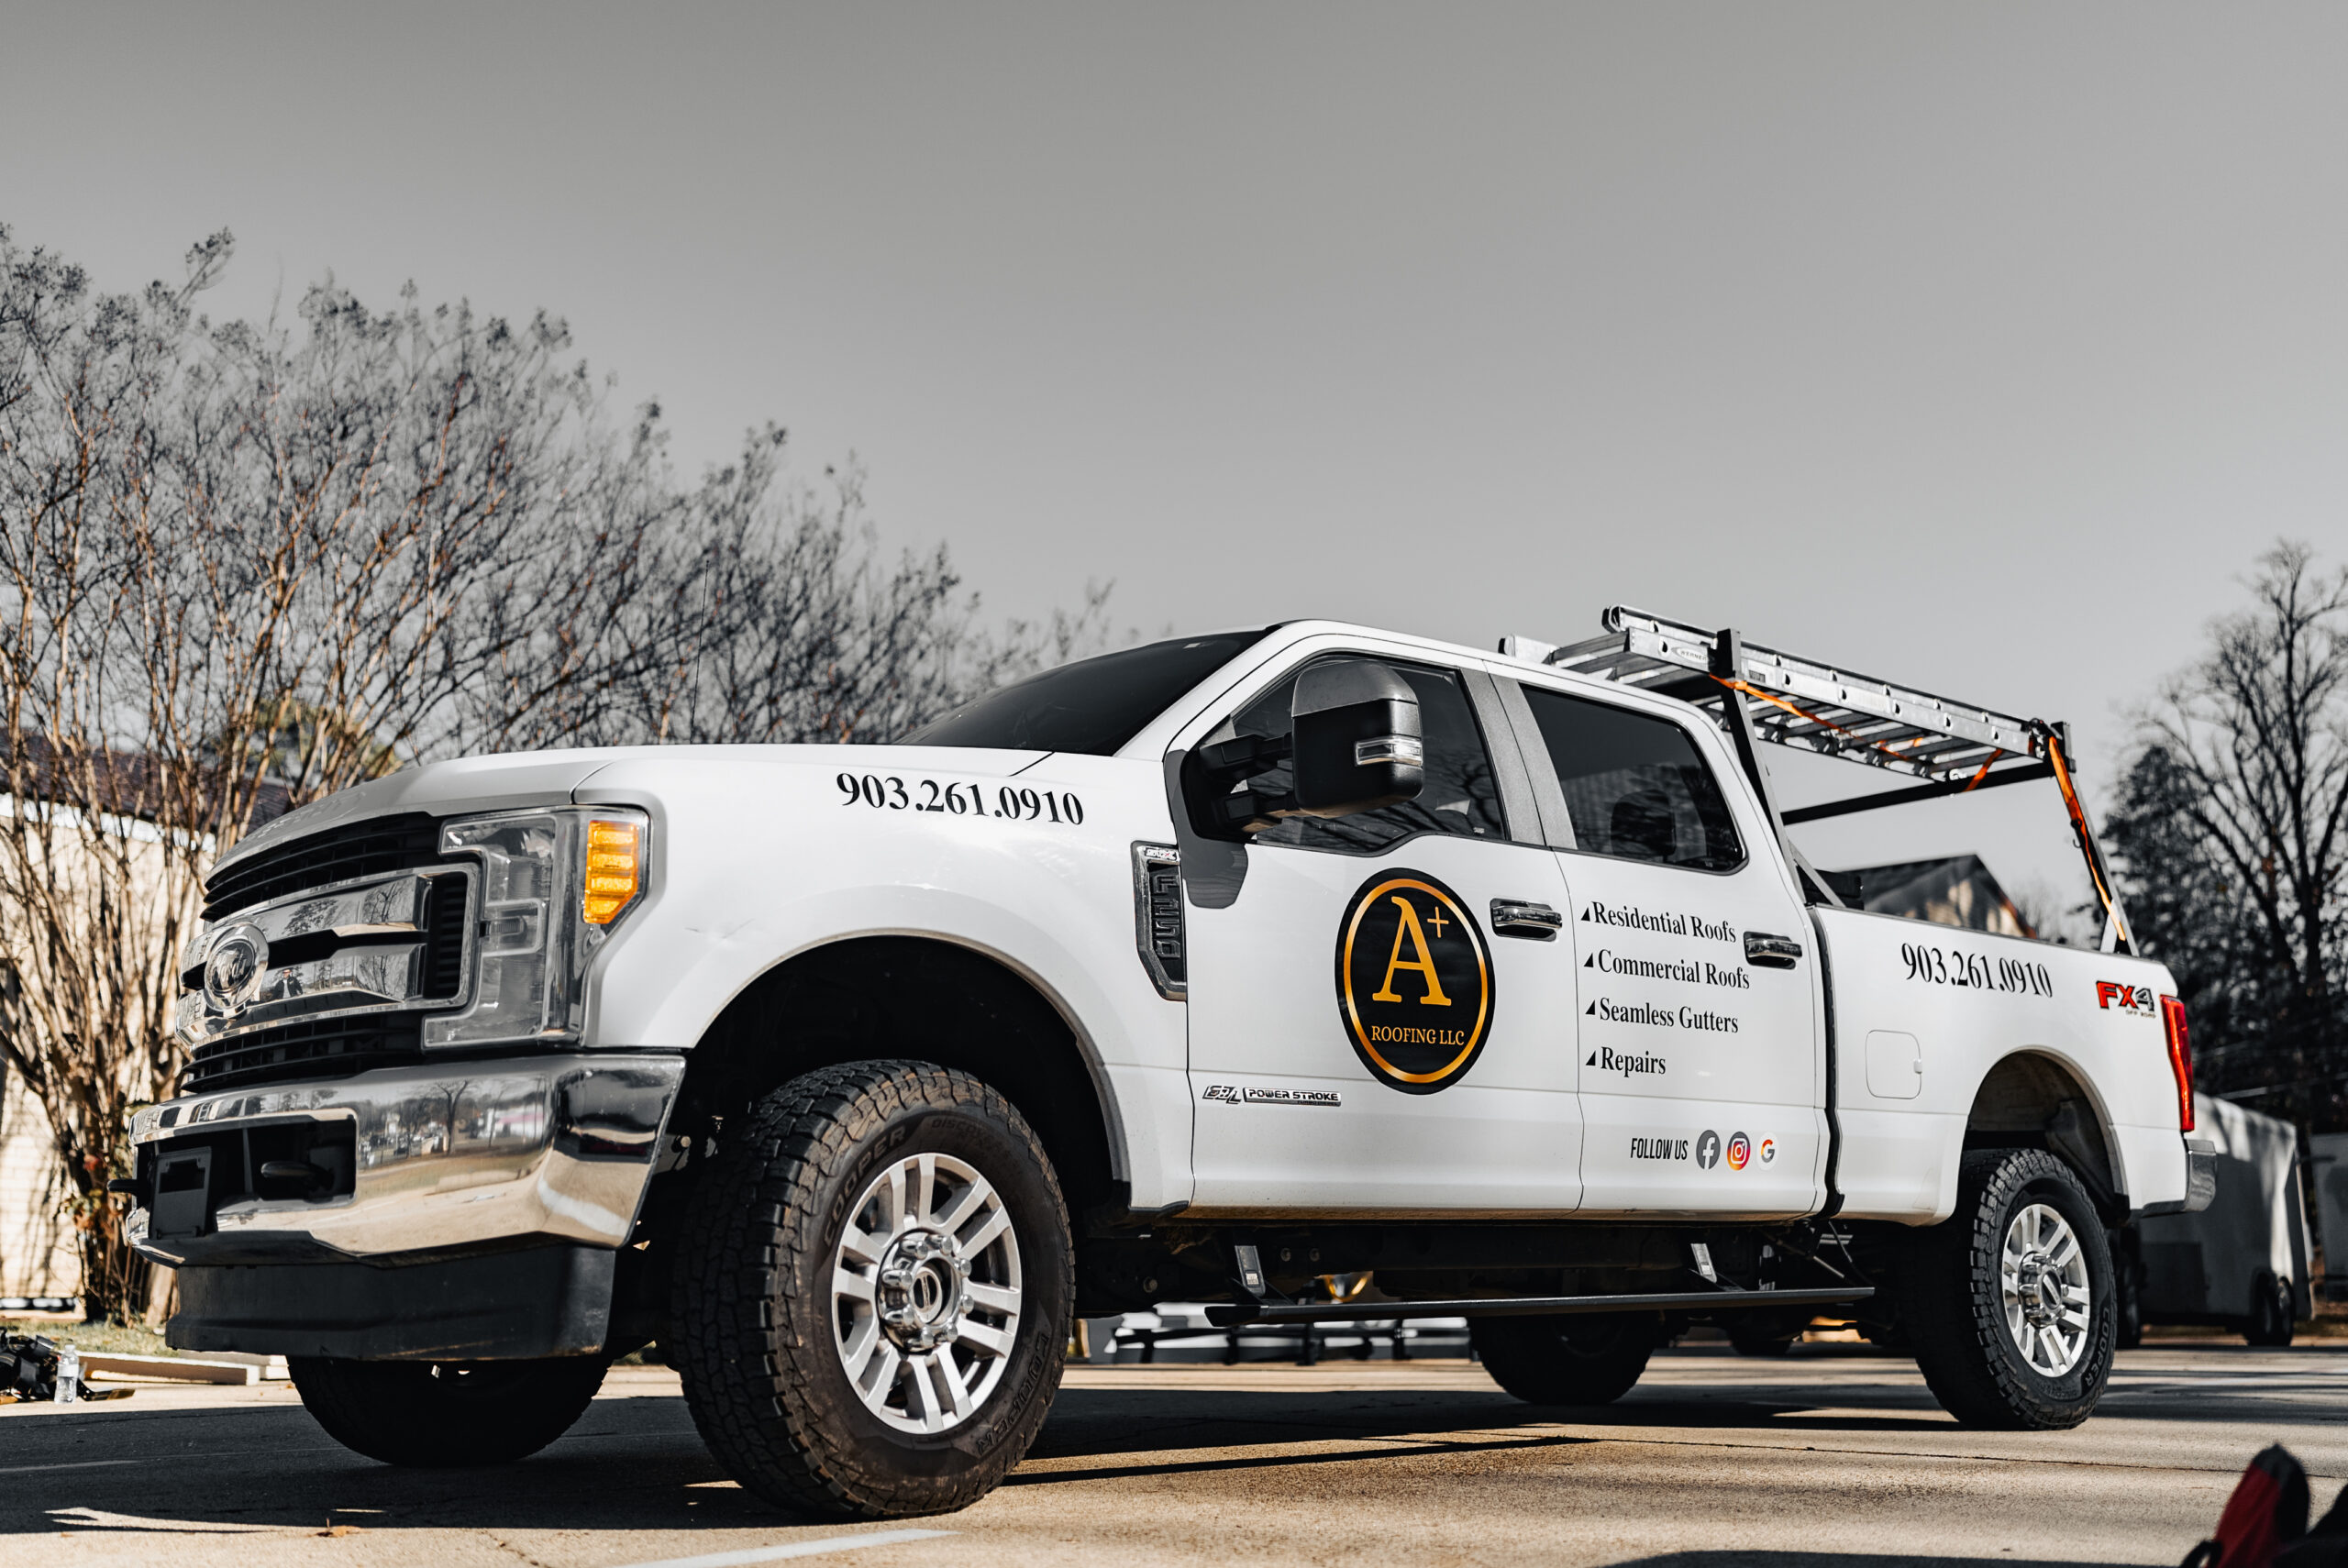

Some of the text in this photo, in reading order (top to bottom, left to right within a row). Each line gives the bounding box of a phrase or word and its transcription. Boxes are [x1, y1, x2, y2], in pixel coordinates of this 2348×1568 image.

[1680, 649, 1708, 661] WERNER
[836, 772, 1084, 825] 903.261.0910
[1590, 900, 1737, 944] Residential Roofs
[1598, 949, 1751, 989] Commercial Roofs
[1901, 943, 2053, 999] 903.261.0910
[2096, 980, 2154, 1012] FX4
[1600, 997, 1739, 1033] Seamless Gutters
[1370, 1025, 1466, 1046] ROOFING LLC
[1600, 1046, 1667, 1078] Repairs
[1248, 1088, 1290, 1099] POWER
[1292, 1090, 1339, 1101] STROKE
[1630, 1137, 1689, 1161] FOLLOW US
[825, 1124, 906, 1248] COOPER
[2084, 1307, 2110, 1386] COOPER
